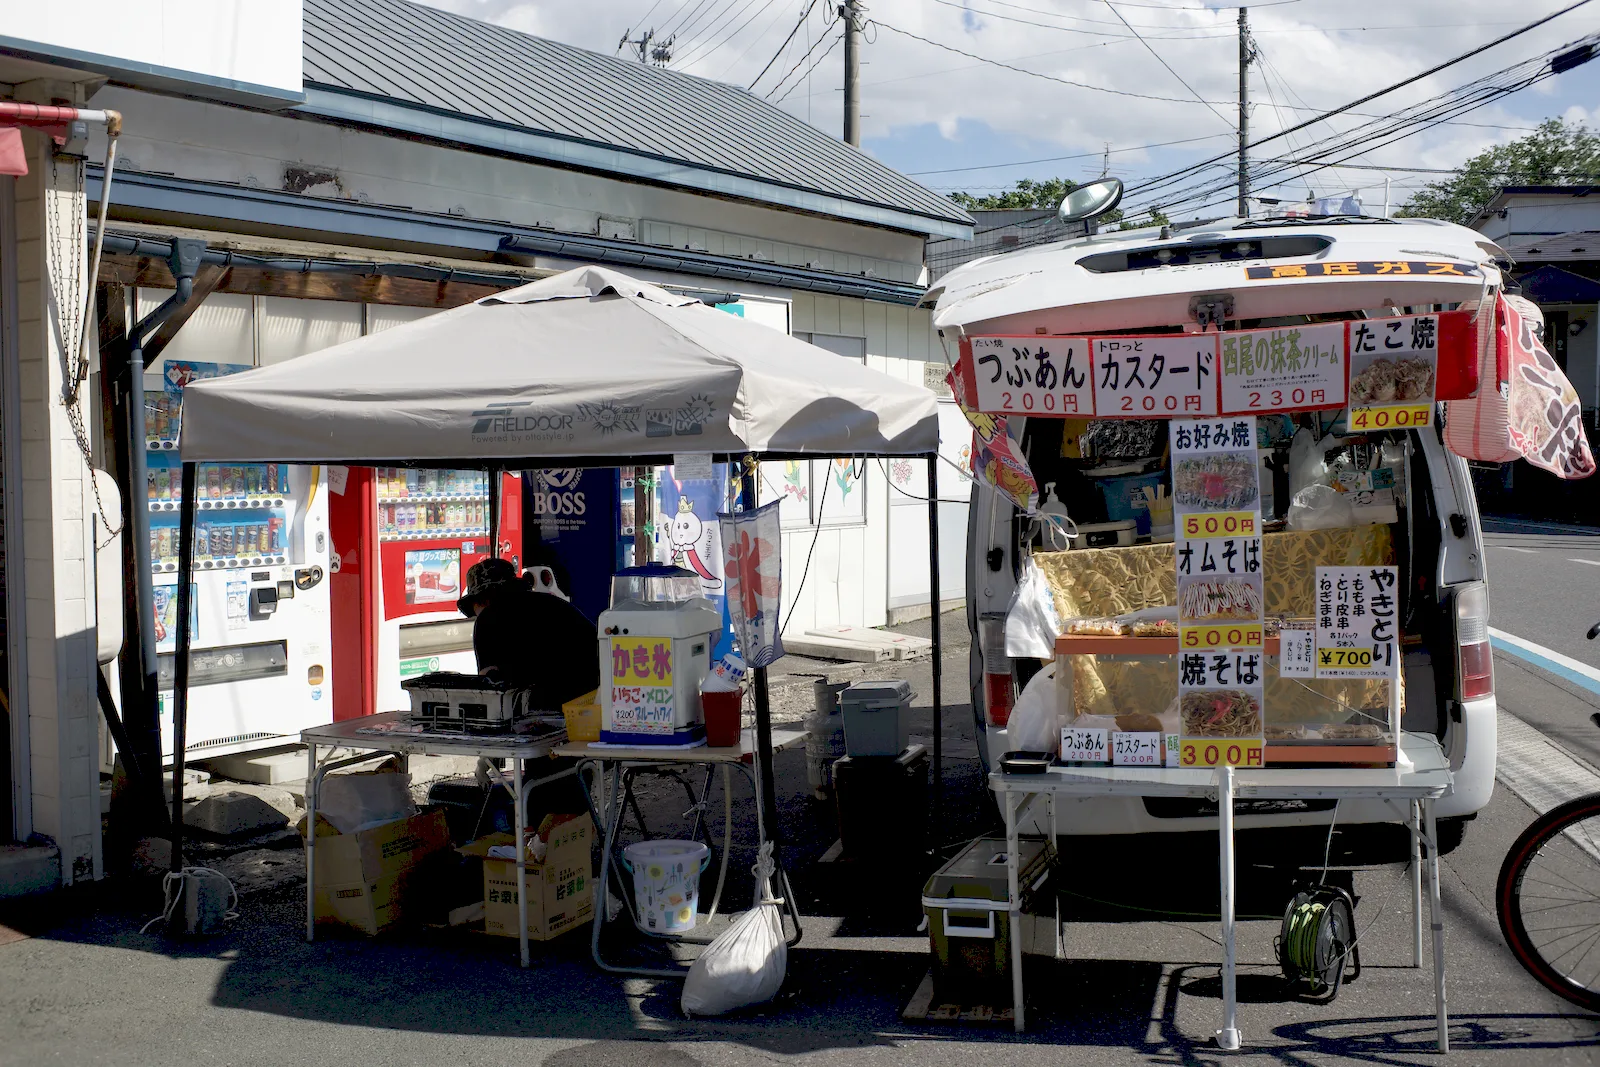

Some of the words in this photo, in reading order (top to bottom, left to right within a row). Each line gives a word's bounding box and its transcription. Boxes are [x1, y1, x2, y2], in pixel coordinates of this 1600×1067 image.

[1270, 261, 1465, 278] 高圧ガス
[975, 339, 1004, 348] たい焼
[1354, 317, 1436, 354] たこ焼
[1100, 341, 1144, 352] トロっと
[1223, 328, 1339, 377] 西尾の抹茶クリーム
[978, 346, 1085, 390] つぶあん
[1101, 351, 1213, 391] カスタード
[1002, 392, 1078, 413] 200円
[1121, 394, 1202, 412] 200円
[1248, 388, 1325, 408] 230円
[494, 414, 573, 433] FIELDOOR
[676, 420, 693, 431] UV
[1354, 409, 1430, 428] 400円
[471, 434, 508, 444] Powered
[511, 433, 522, 445] by
[525, 431, 575, 443] ottostyle.jp
[1176, 421, 1250, 450] お好み焼
[533, 491, 586, 516] BOSS
[1187, 516, 1254, 534] 500円
[1178, 538, 1261, 575] オムそば
[1369, 568, 1395, 667] やきとり
[1185, 629, 1262, 647] 500円
[612, 643, 672, 681] かき氷
[1320, 651, 1371, 665] ¥700
[1180, 653, 1260, 686] 焼そば
[612, 687, 673, 705] いちご・メロン
[615, 709, 635, 720] ¥200
[635, 706, 672, 722] ブルーハワイ
[1063, 733, 1105, 751] つぶあん
[1116, 738, 1158, 754] カスタード
[1071, 751, 1101, 760] 200円
[1123, 755, 1154, 763] 200円
[1182, 744, 1263, 766] 300円
